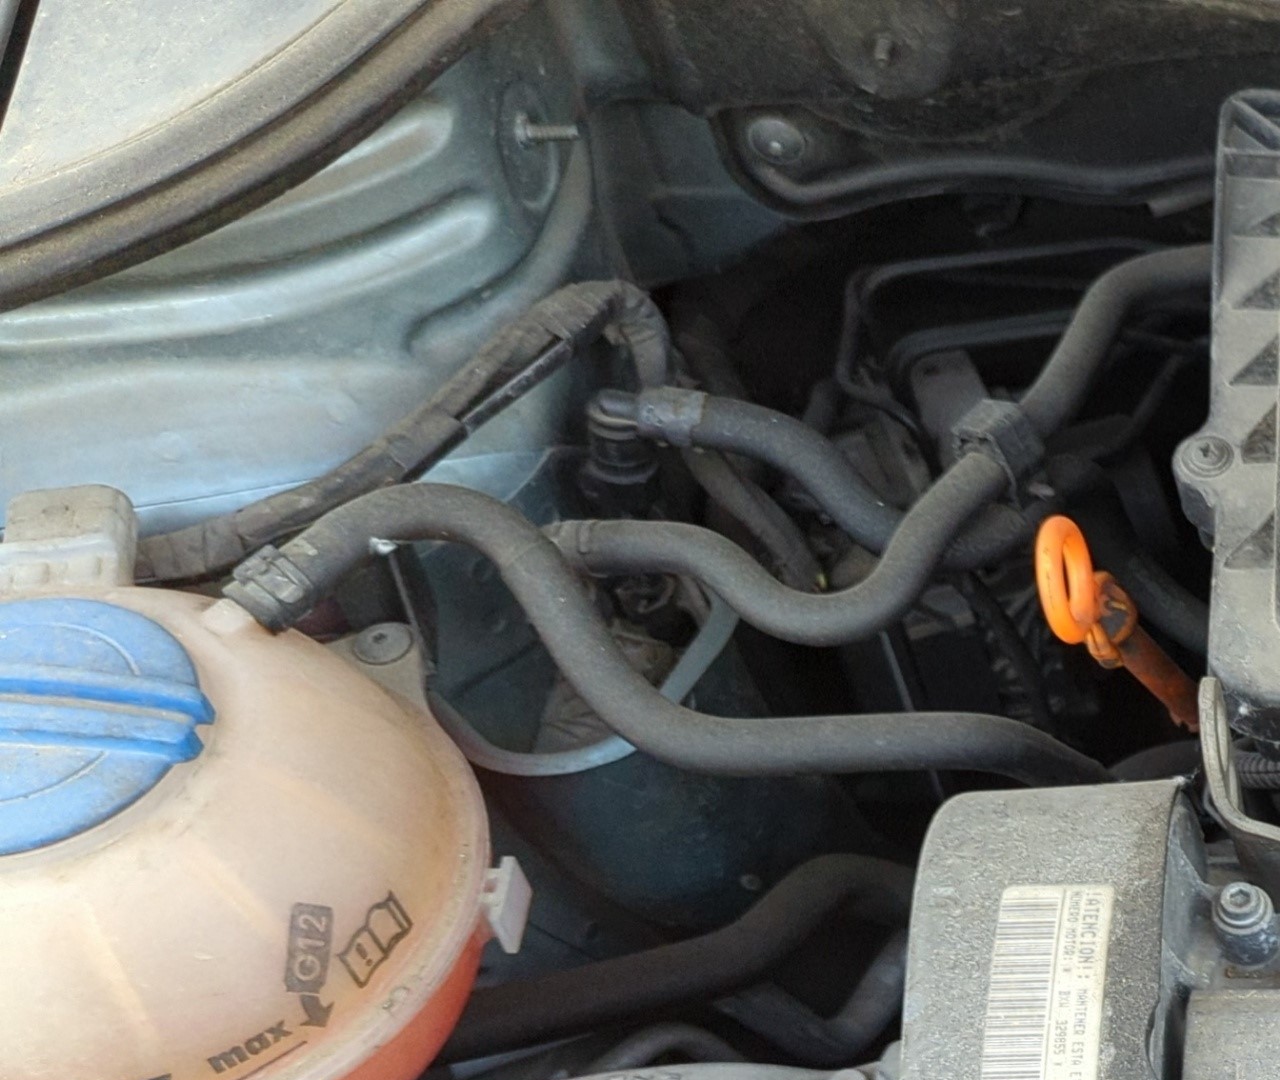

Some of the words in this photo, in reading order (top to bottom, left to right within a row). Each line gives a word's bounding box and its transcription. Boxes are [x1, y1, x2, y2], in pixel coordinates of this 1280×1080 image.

[293, 913, 328, 981] G12
[207, 1019, 293, 1074] max
[1053, 1020, 1068, 1056] 329855
[1071, 1036, 1085, 1066] ESTA
